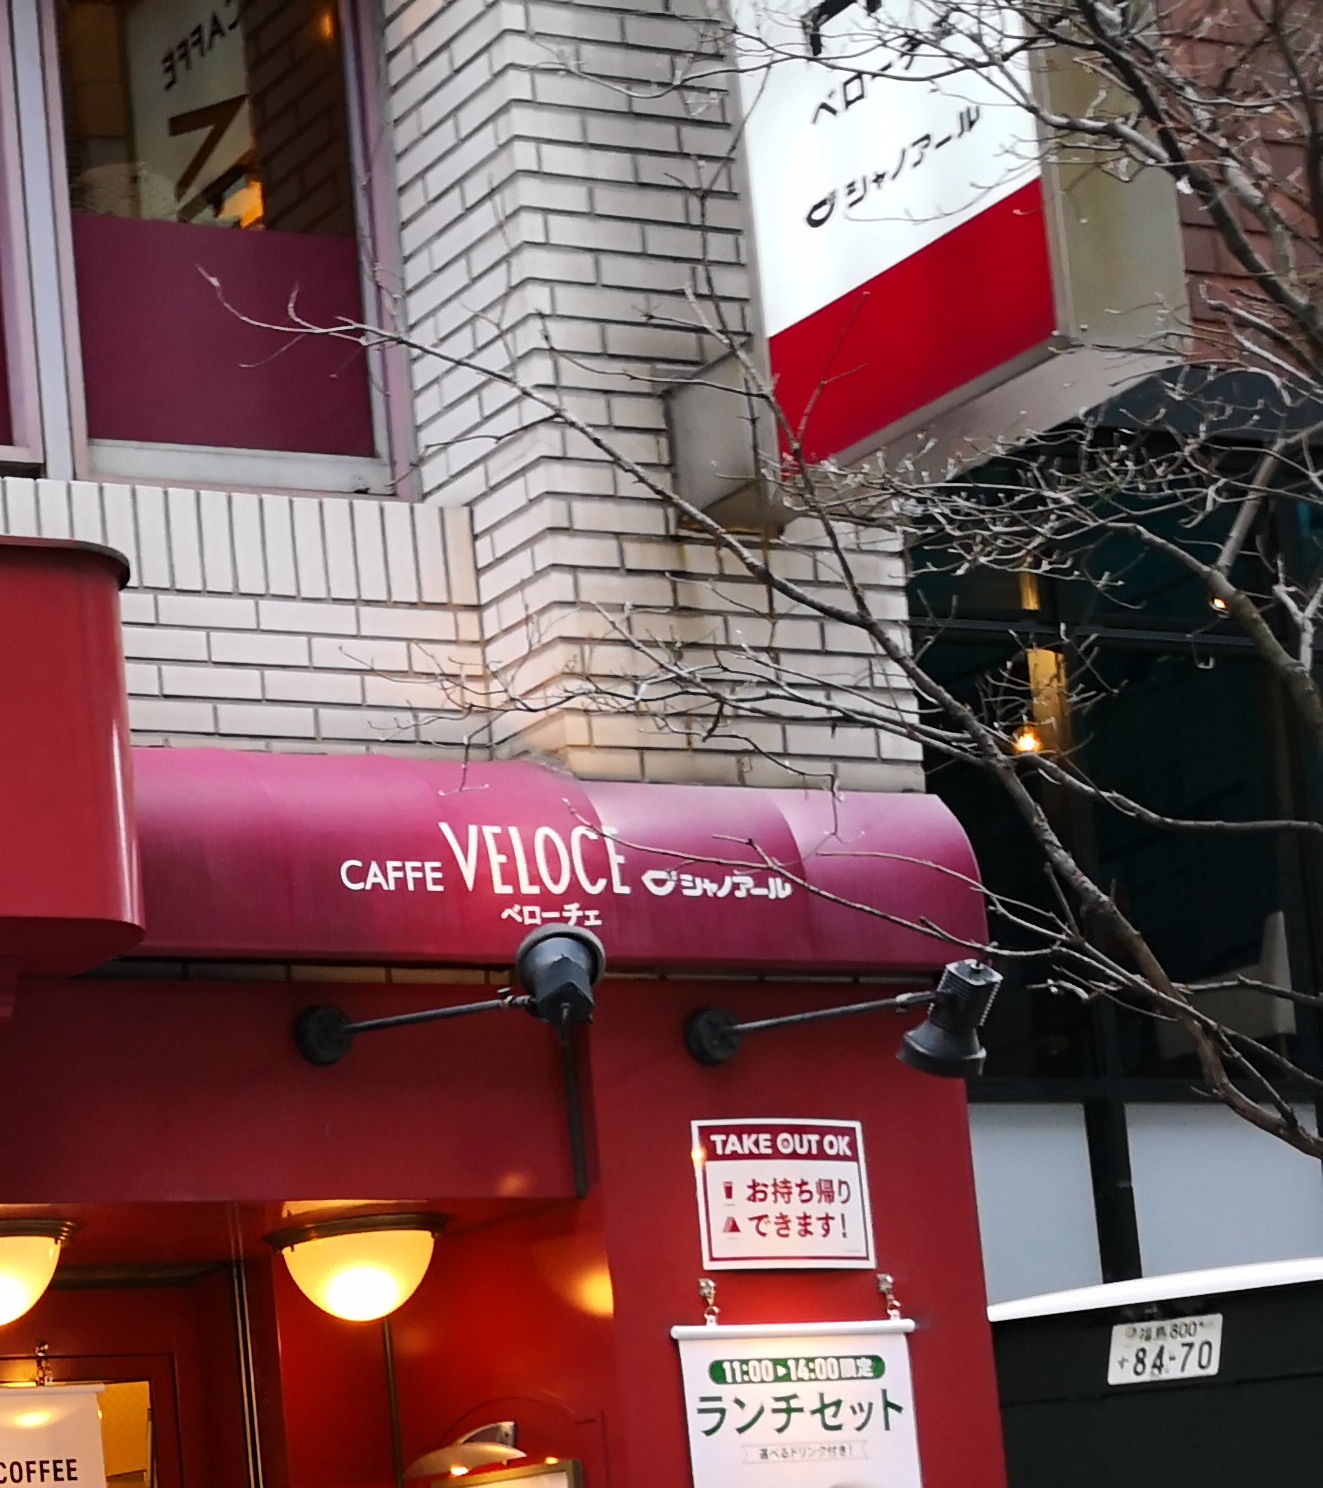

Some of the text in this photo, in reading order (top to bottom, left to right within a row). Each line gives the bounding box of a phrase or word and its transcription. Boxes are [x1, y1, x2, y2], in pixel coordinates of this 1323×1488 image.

[340, 821, 792, 899] CAFFE VELOCE シャノアール
[500, 902, 602, 927] ベローチェ
[710, 1132, 852, 1156] TAKE OUT OK
[746, 1178, 851, 1205] お持ち帰り
[722, 1360, 775, 1383] 11:00
[697, 1388, 903, 1436] ランチセット
